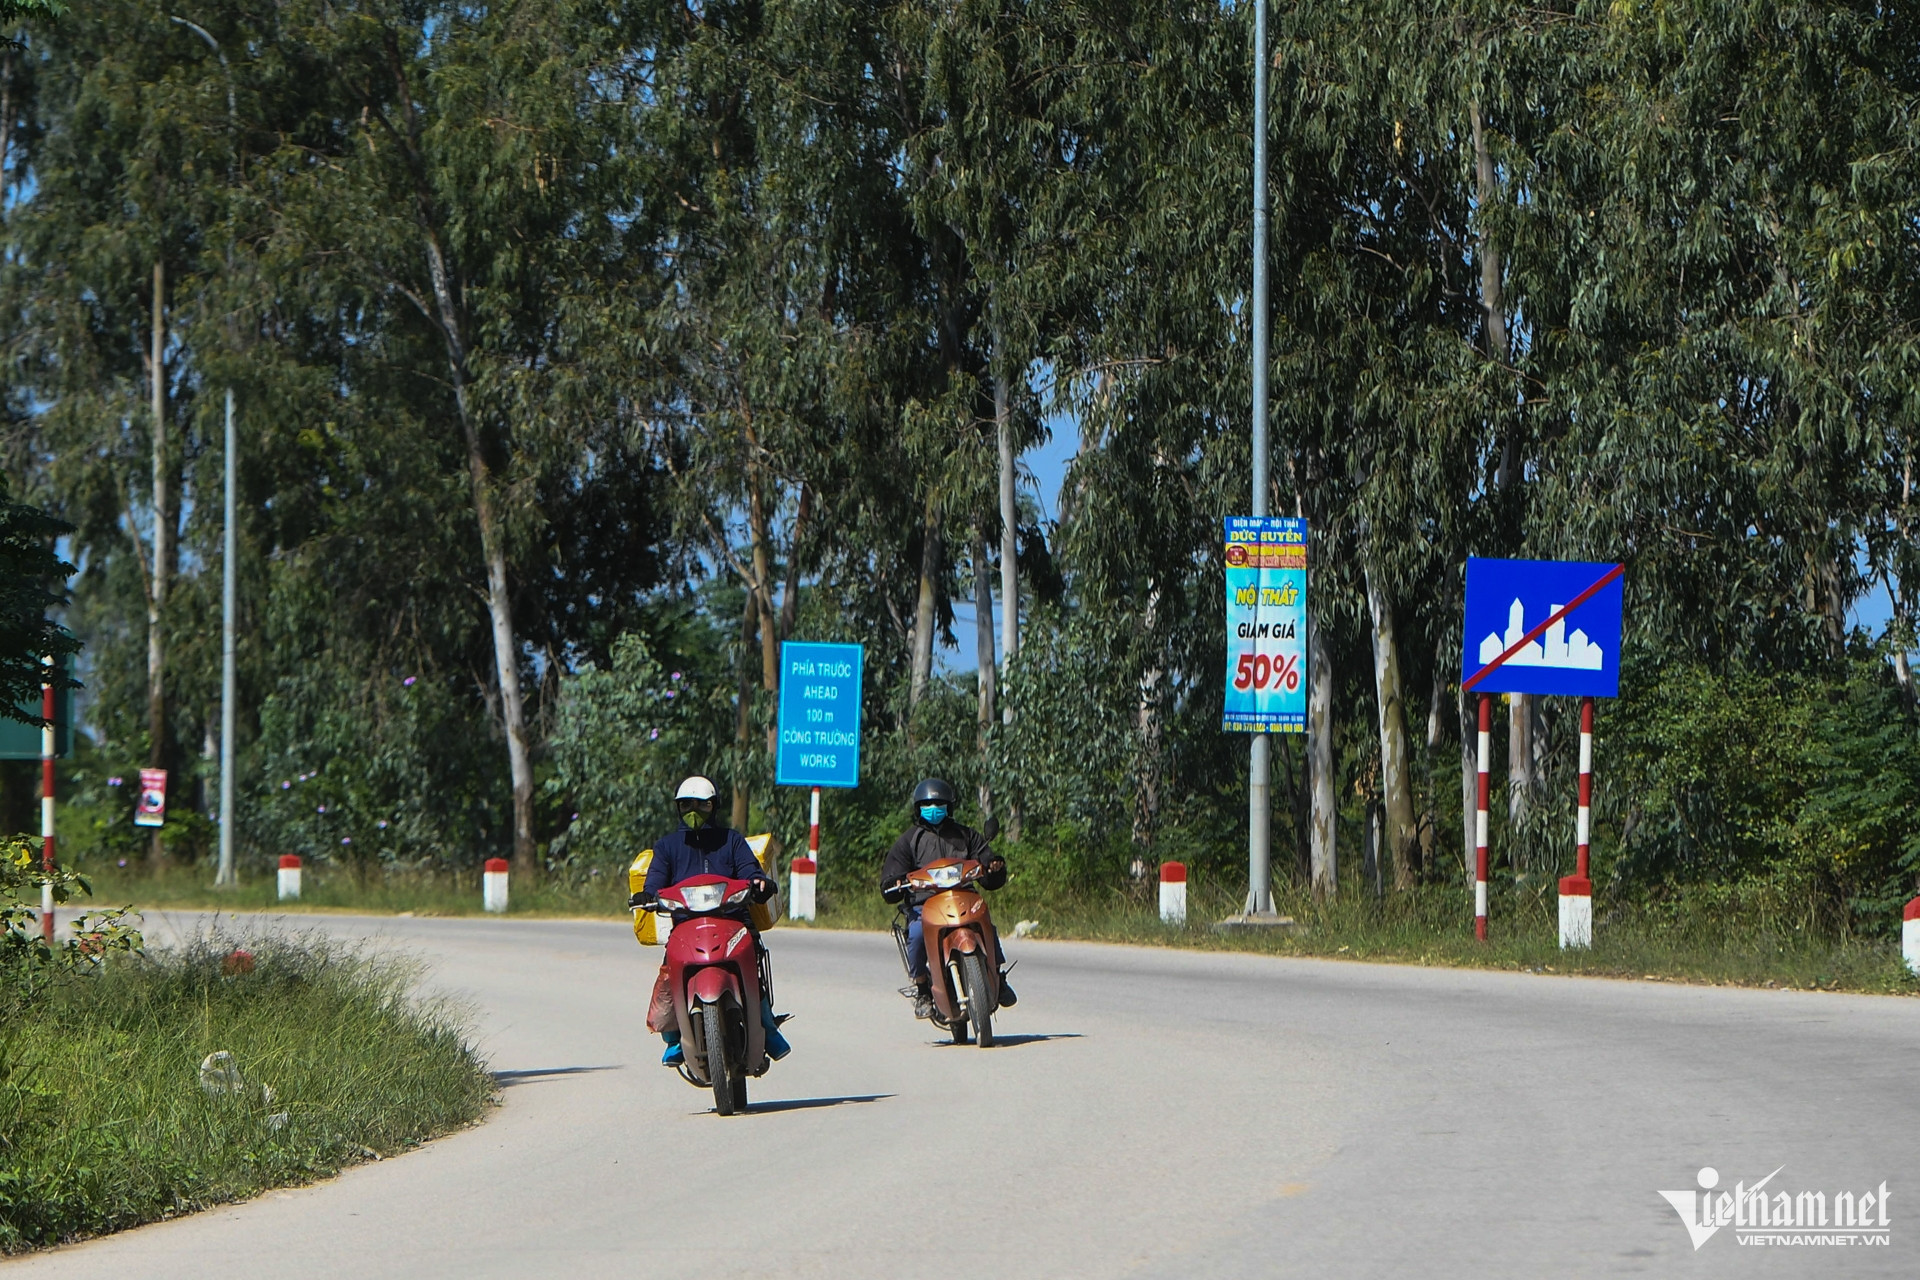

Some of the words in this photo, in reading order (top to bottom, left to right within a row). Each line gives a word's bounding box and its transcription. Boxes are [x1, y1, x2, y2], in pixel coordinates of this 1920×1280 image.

[1230, 528, 1257, 542] ĐỨC
[1235, 584, 1258, 609] NỘ
[1261, 581, 1299, 606] THẤT
[1272, 619, 1295, 639] GIÁ
[792, 659, 815, 677] PHÍA
[1234, 653, 1298, 691] 50%
[803, 684, 838, 700] AHEAD
[806, 708, 823, 723] 100
[824, 711, 834, 723] m
[783, 727, 812, 745] CÔNG
[814, 728, 855, 747] TRƯỜNG
[800, 753, 837, 769] WORKS
